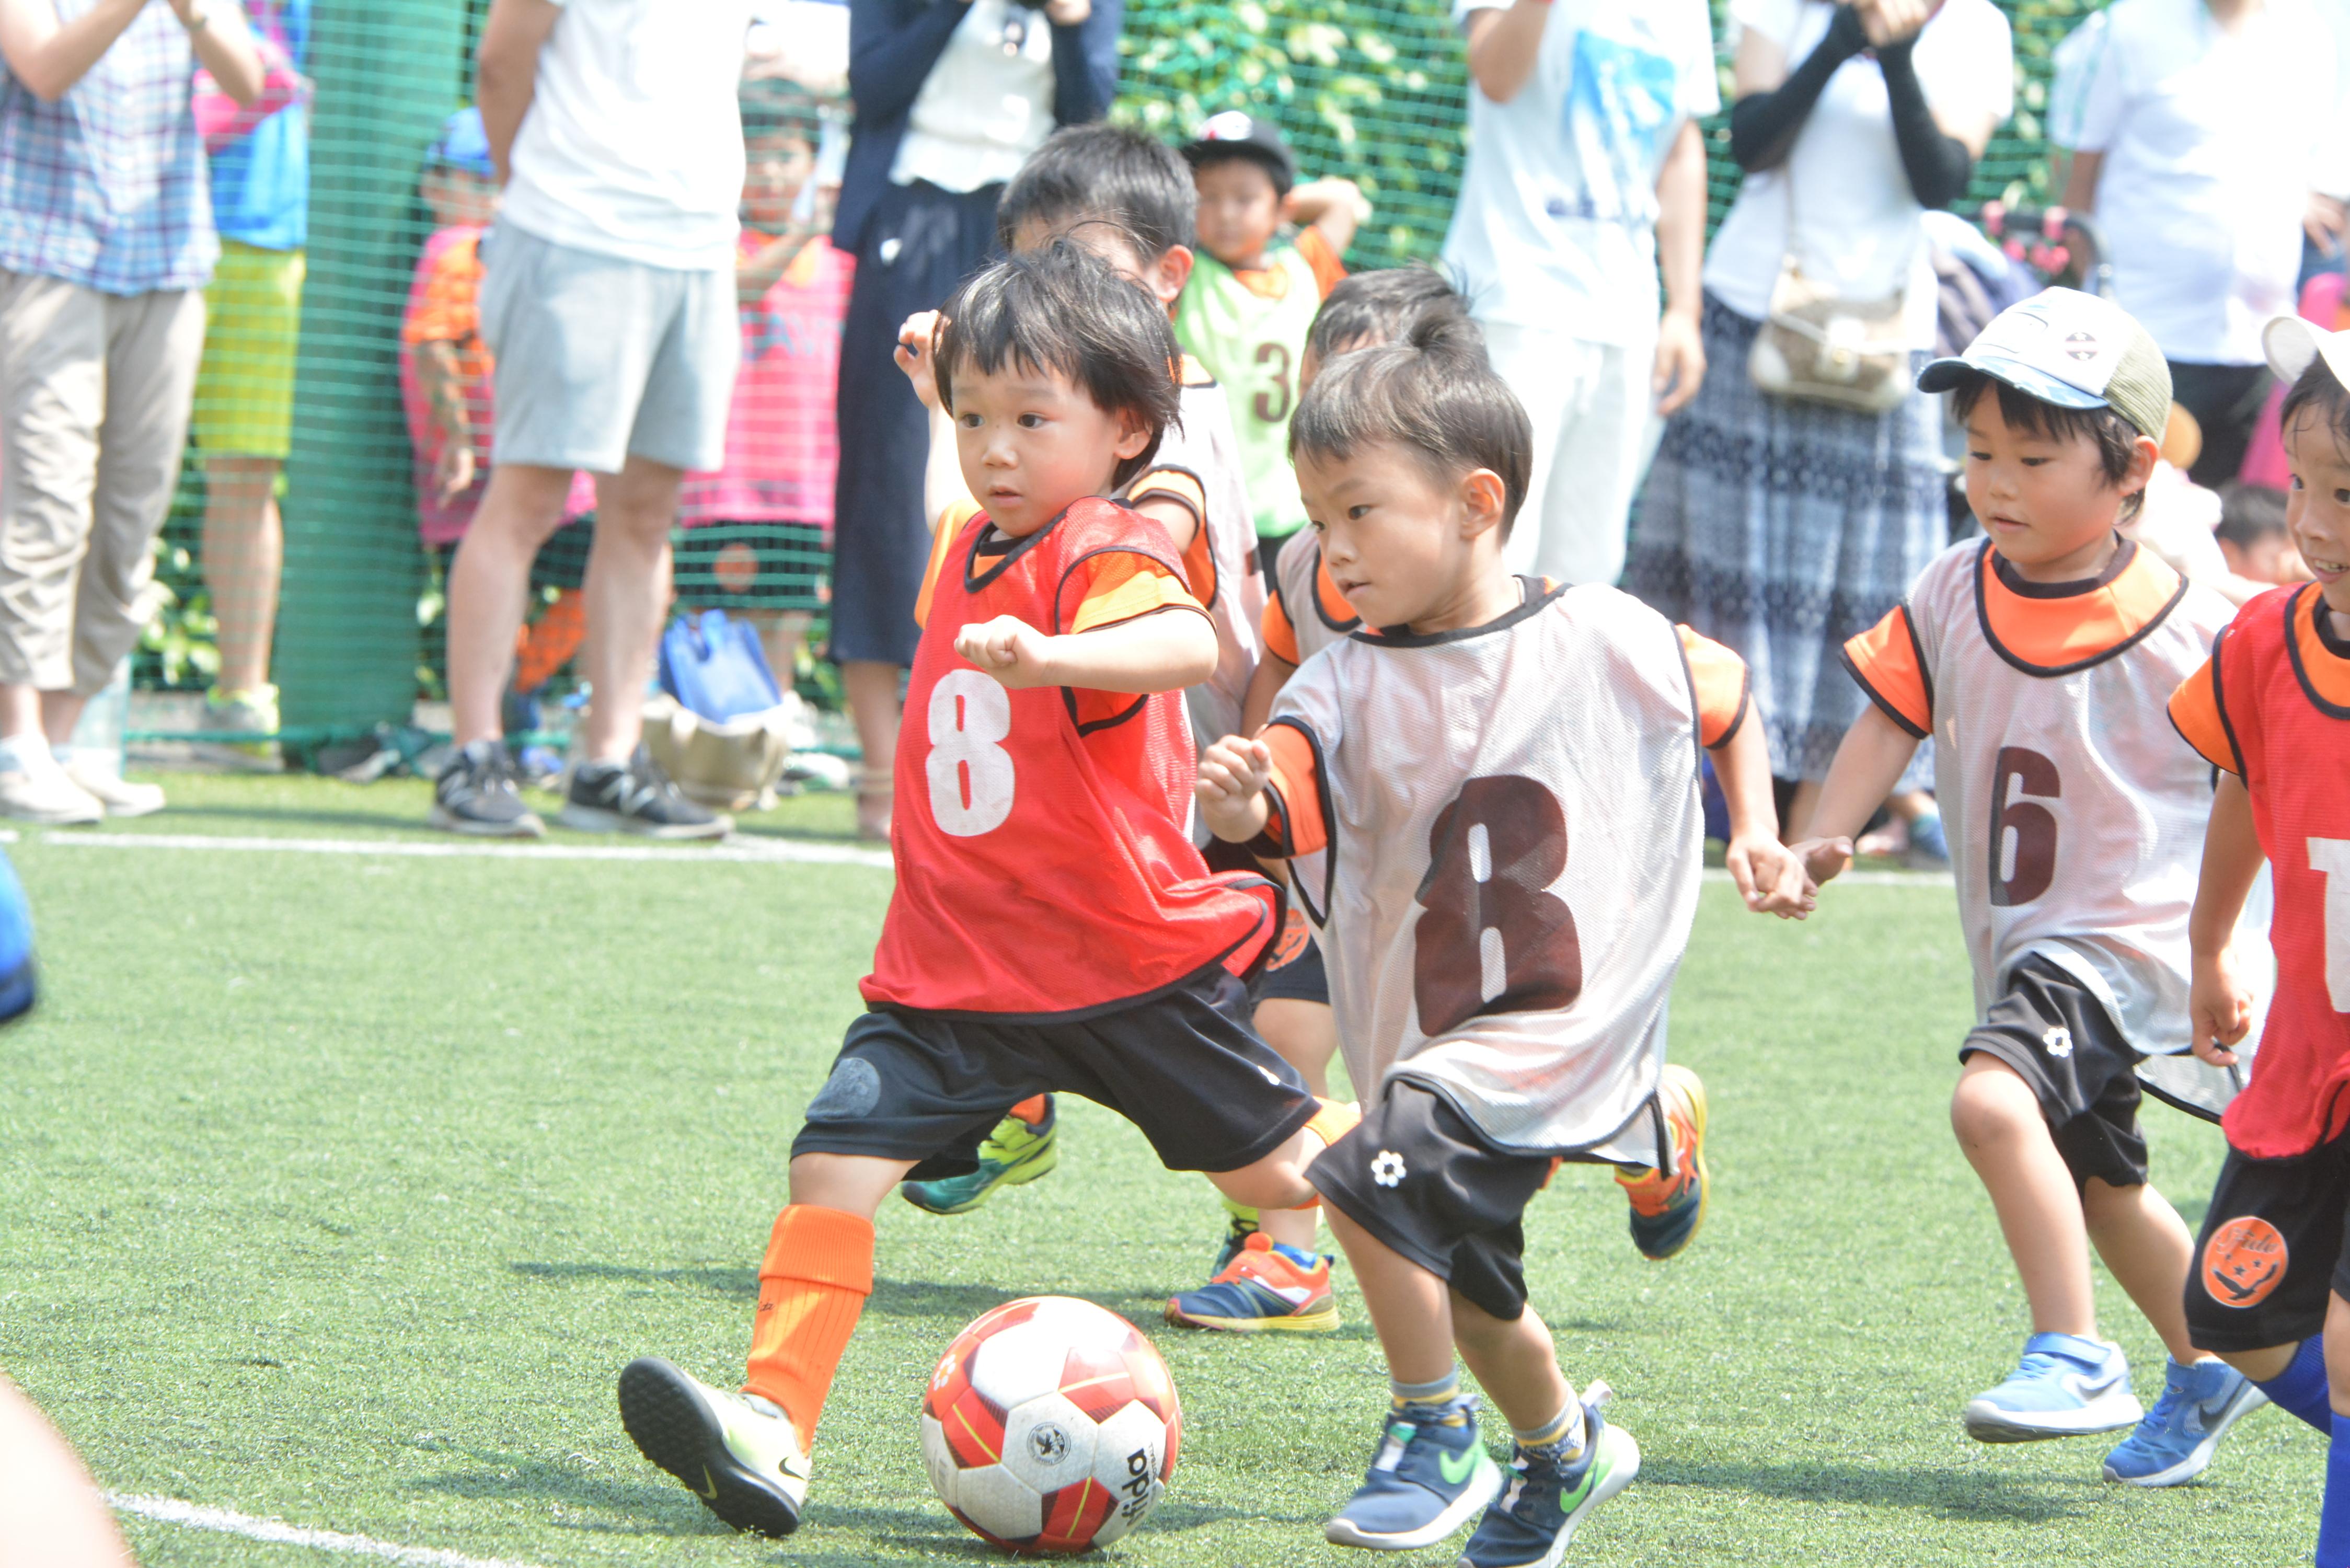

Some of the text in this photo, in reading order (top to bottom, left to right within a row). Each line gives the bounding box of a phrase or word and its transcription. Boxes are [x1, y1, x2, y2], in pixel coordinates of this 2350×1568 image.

[1255, 342, 1290, 422] 3
[926, 668, 1016, 837] 8
[1989, 746, 2060, 907] 6
[1414, 774, 1583, 1037] 8
